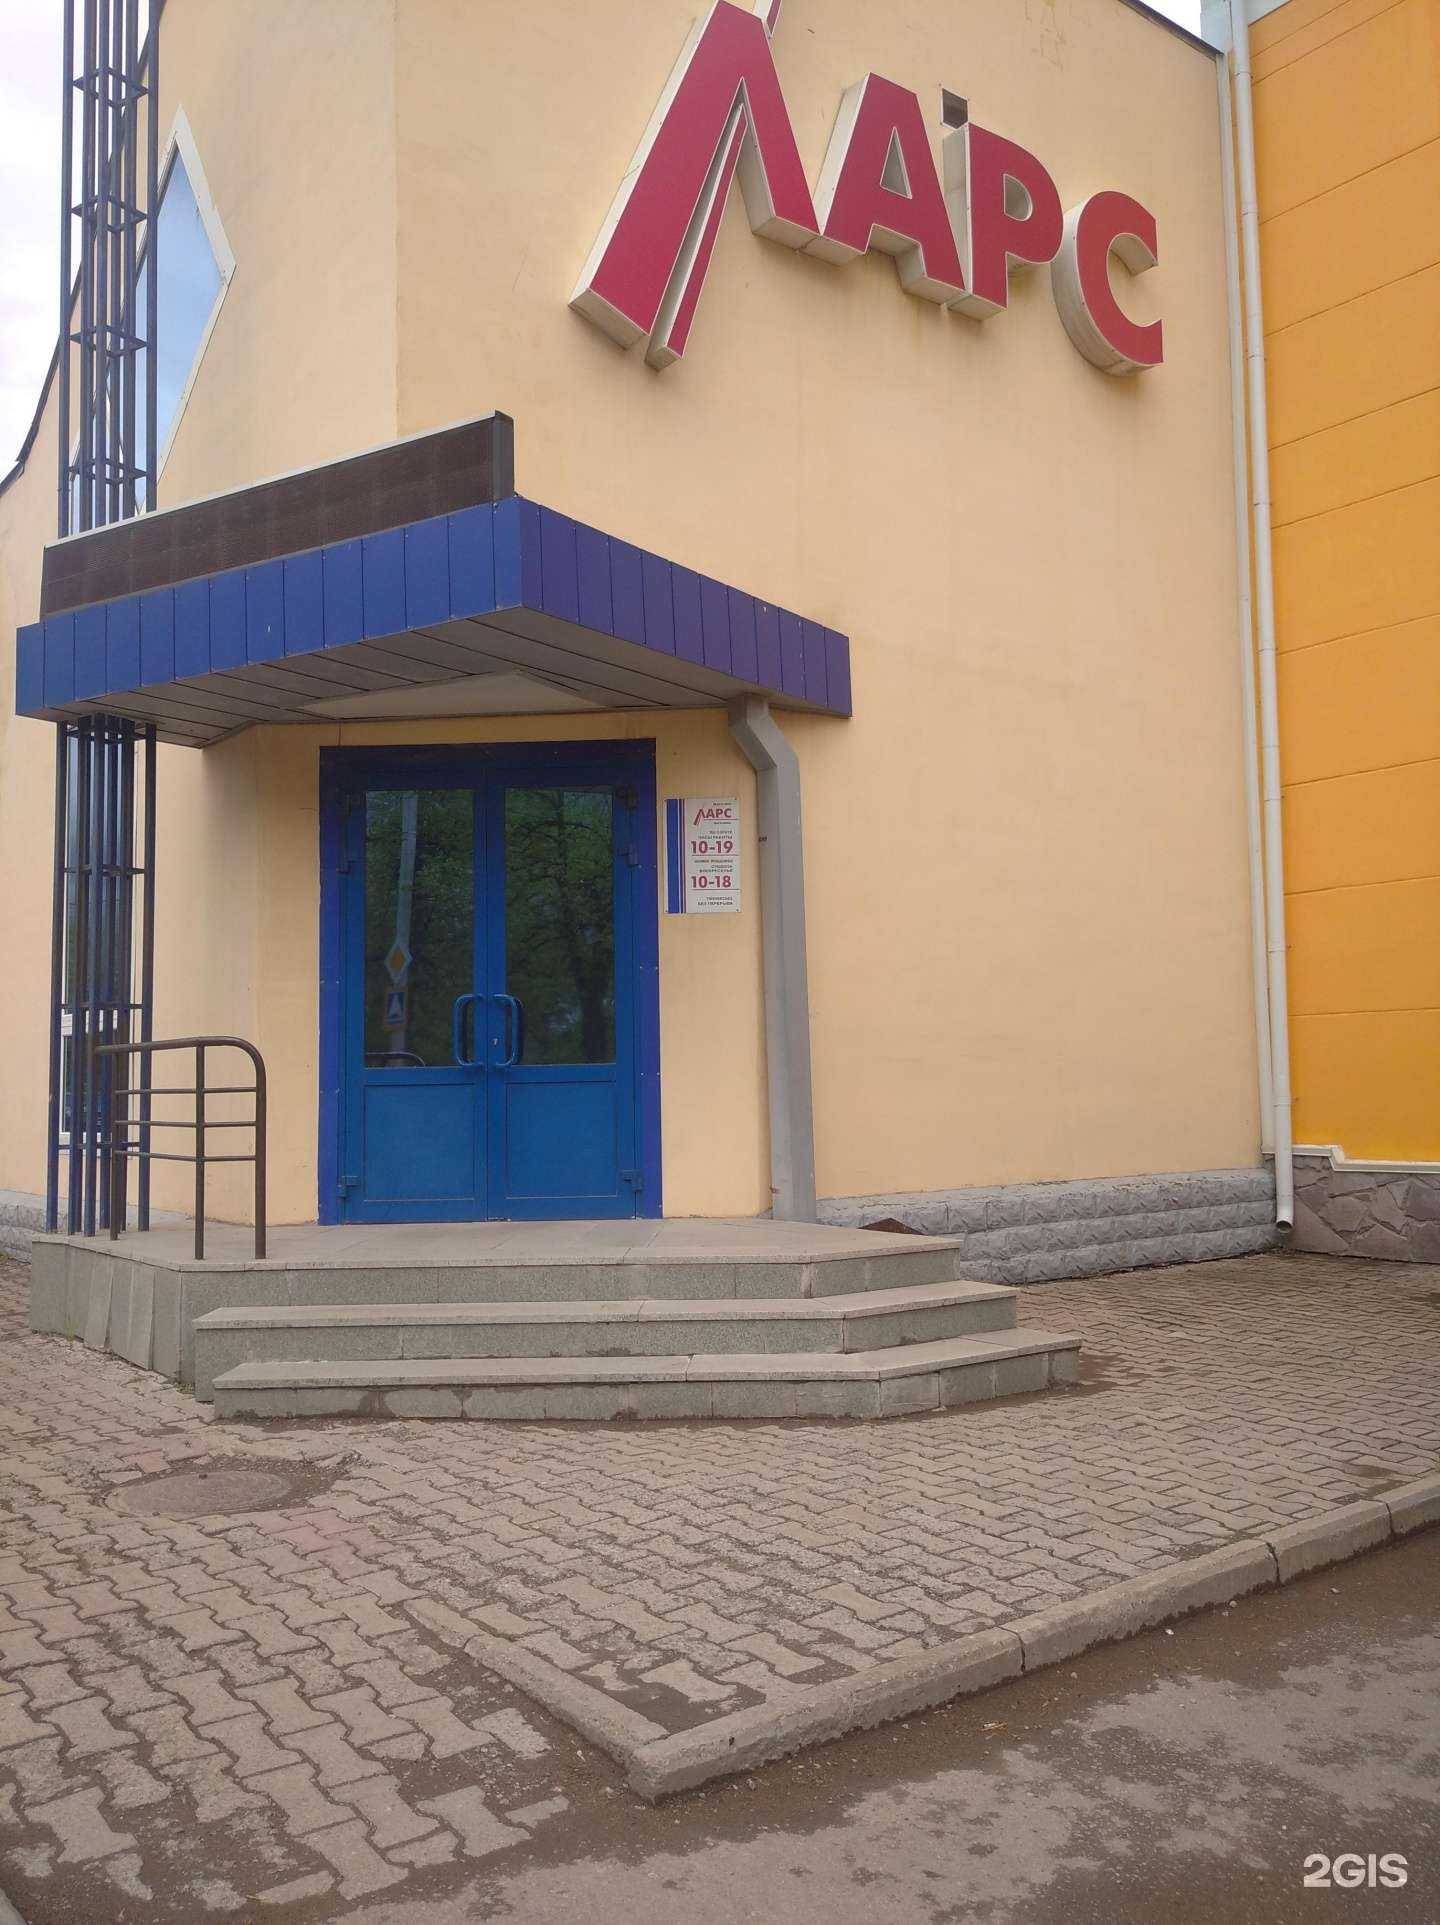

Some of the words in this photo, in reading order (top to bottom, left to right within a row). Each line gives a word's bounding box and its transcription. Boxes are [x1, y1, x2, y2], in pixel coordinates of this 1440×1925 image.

[570, 0, 1163, 372] ЛАРС
[693, 808, 732, 826] ЛАРС
[691, 841, 733, 854] 10-19
[691, 876, 732, 888] 10-18
